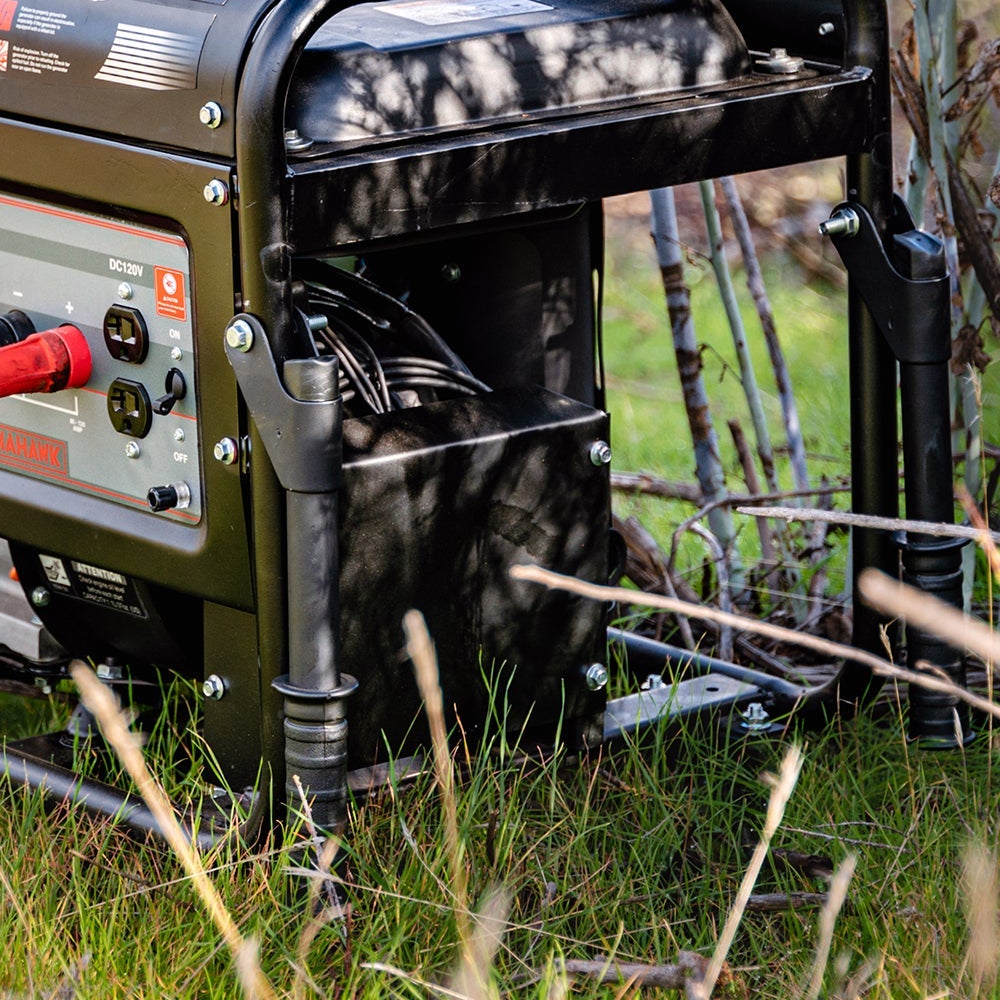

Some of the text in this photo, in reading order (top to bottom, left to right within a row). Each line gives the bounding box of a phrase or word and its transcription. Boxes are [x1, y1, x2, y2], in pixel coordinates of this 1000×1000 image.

[109, 257, 144, 278] DC120V
[169, 328, 181, 340] ON
[173, 451, 189, 464] OFF
[77, 562, 122, 584] ATTENTION
